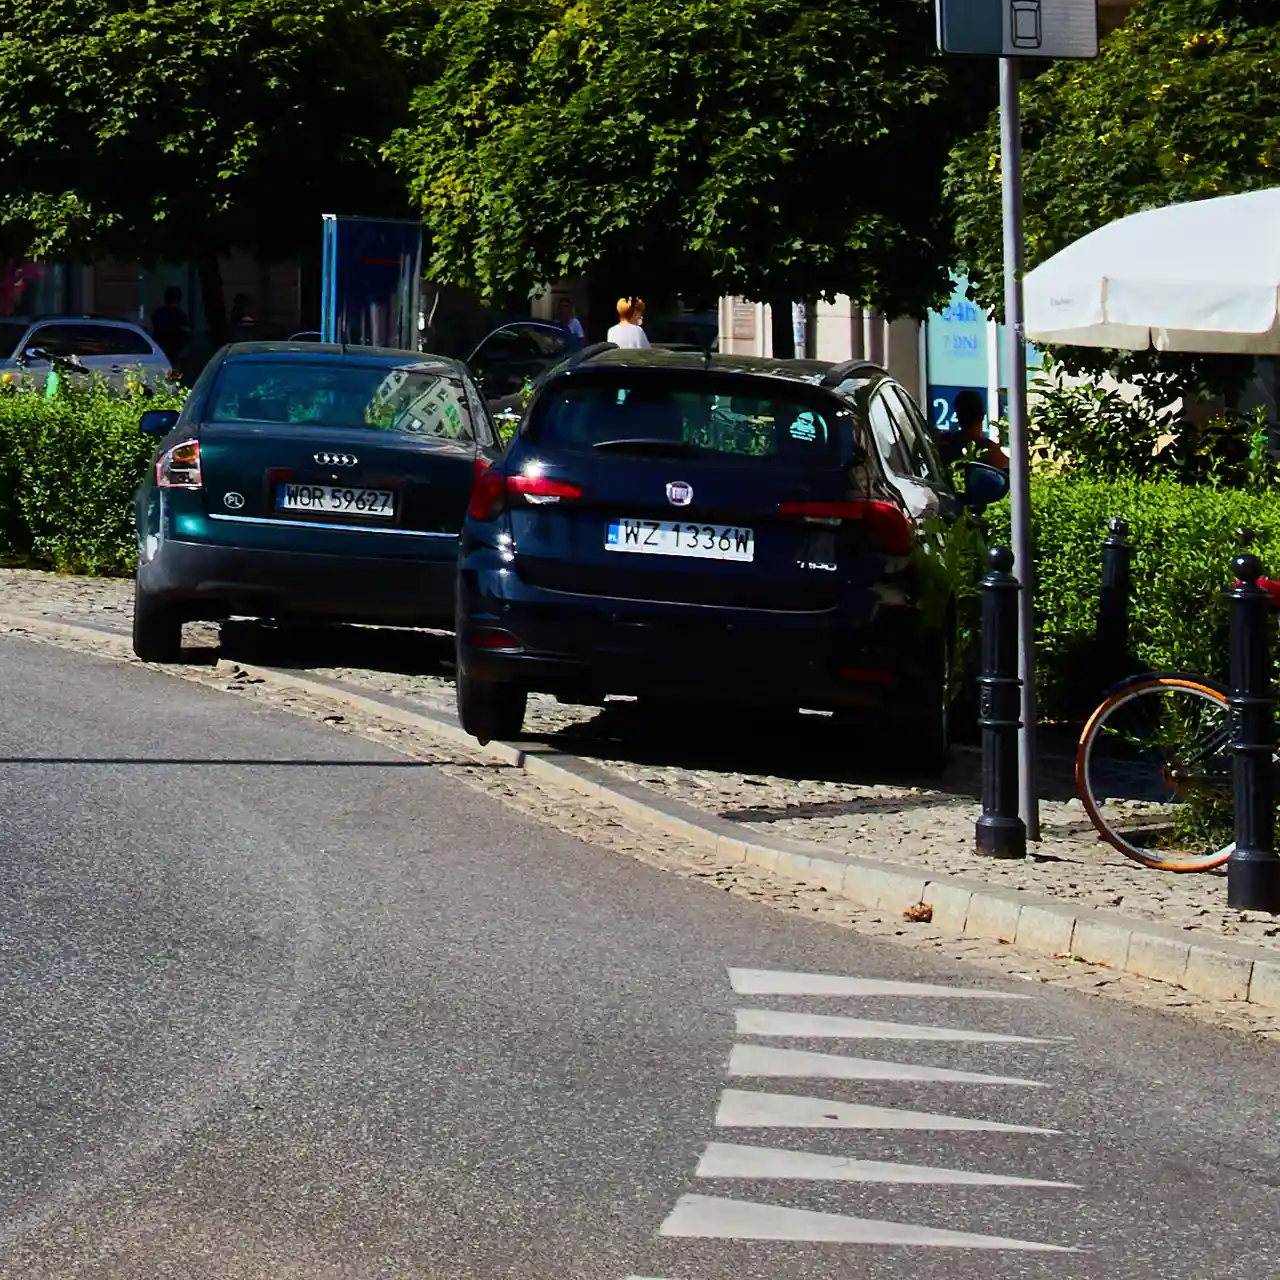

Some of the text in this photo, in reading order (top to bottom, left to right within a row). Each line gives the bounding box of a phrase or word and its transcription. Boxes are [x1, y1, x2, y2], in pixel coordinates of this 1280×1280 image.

[285, 484, 390, 513] WOR 59627
[624, 521, 752, 554] WZ 1336W
